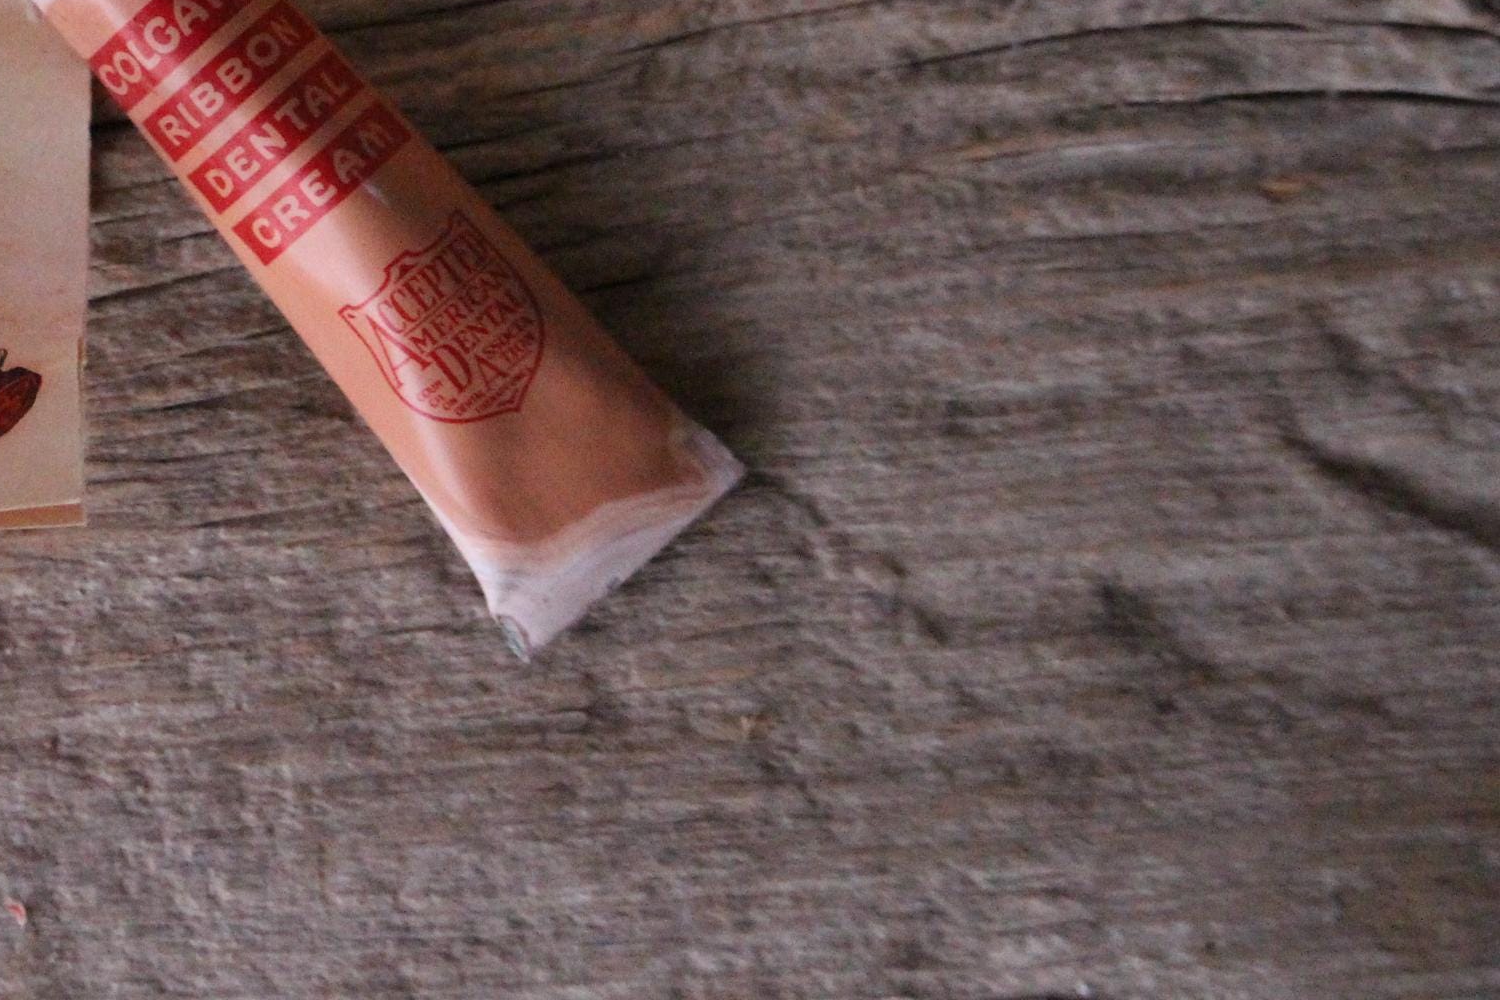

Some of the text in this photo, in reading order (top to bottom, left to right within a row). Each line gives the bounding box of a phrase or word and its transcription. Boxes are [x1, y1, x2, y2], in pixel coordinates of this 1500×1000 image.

[157, 13, 303, 146] RIBBON
[205, 72, 352, 198] DENTAL
[251, 120, 397, 249] CREAM
